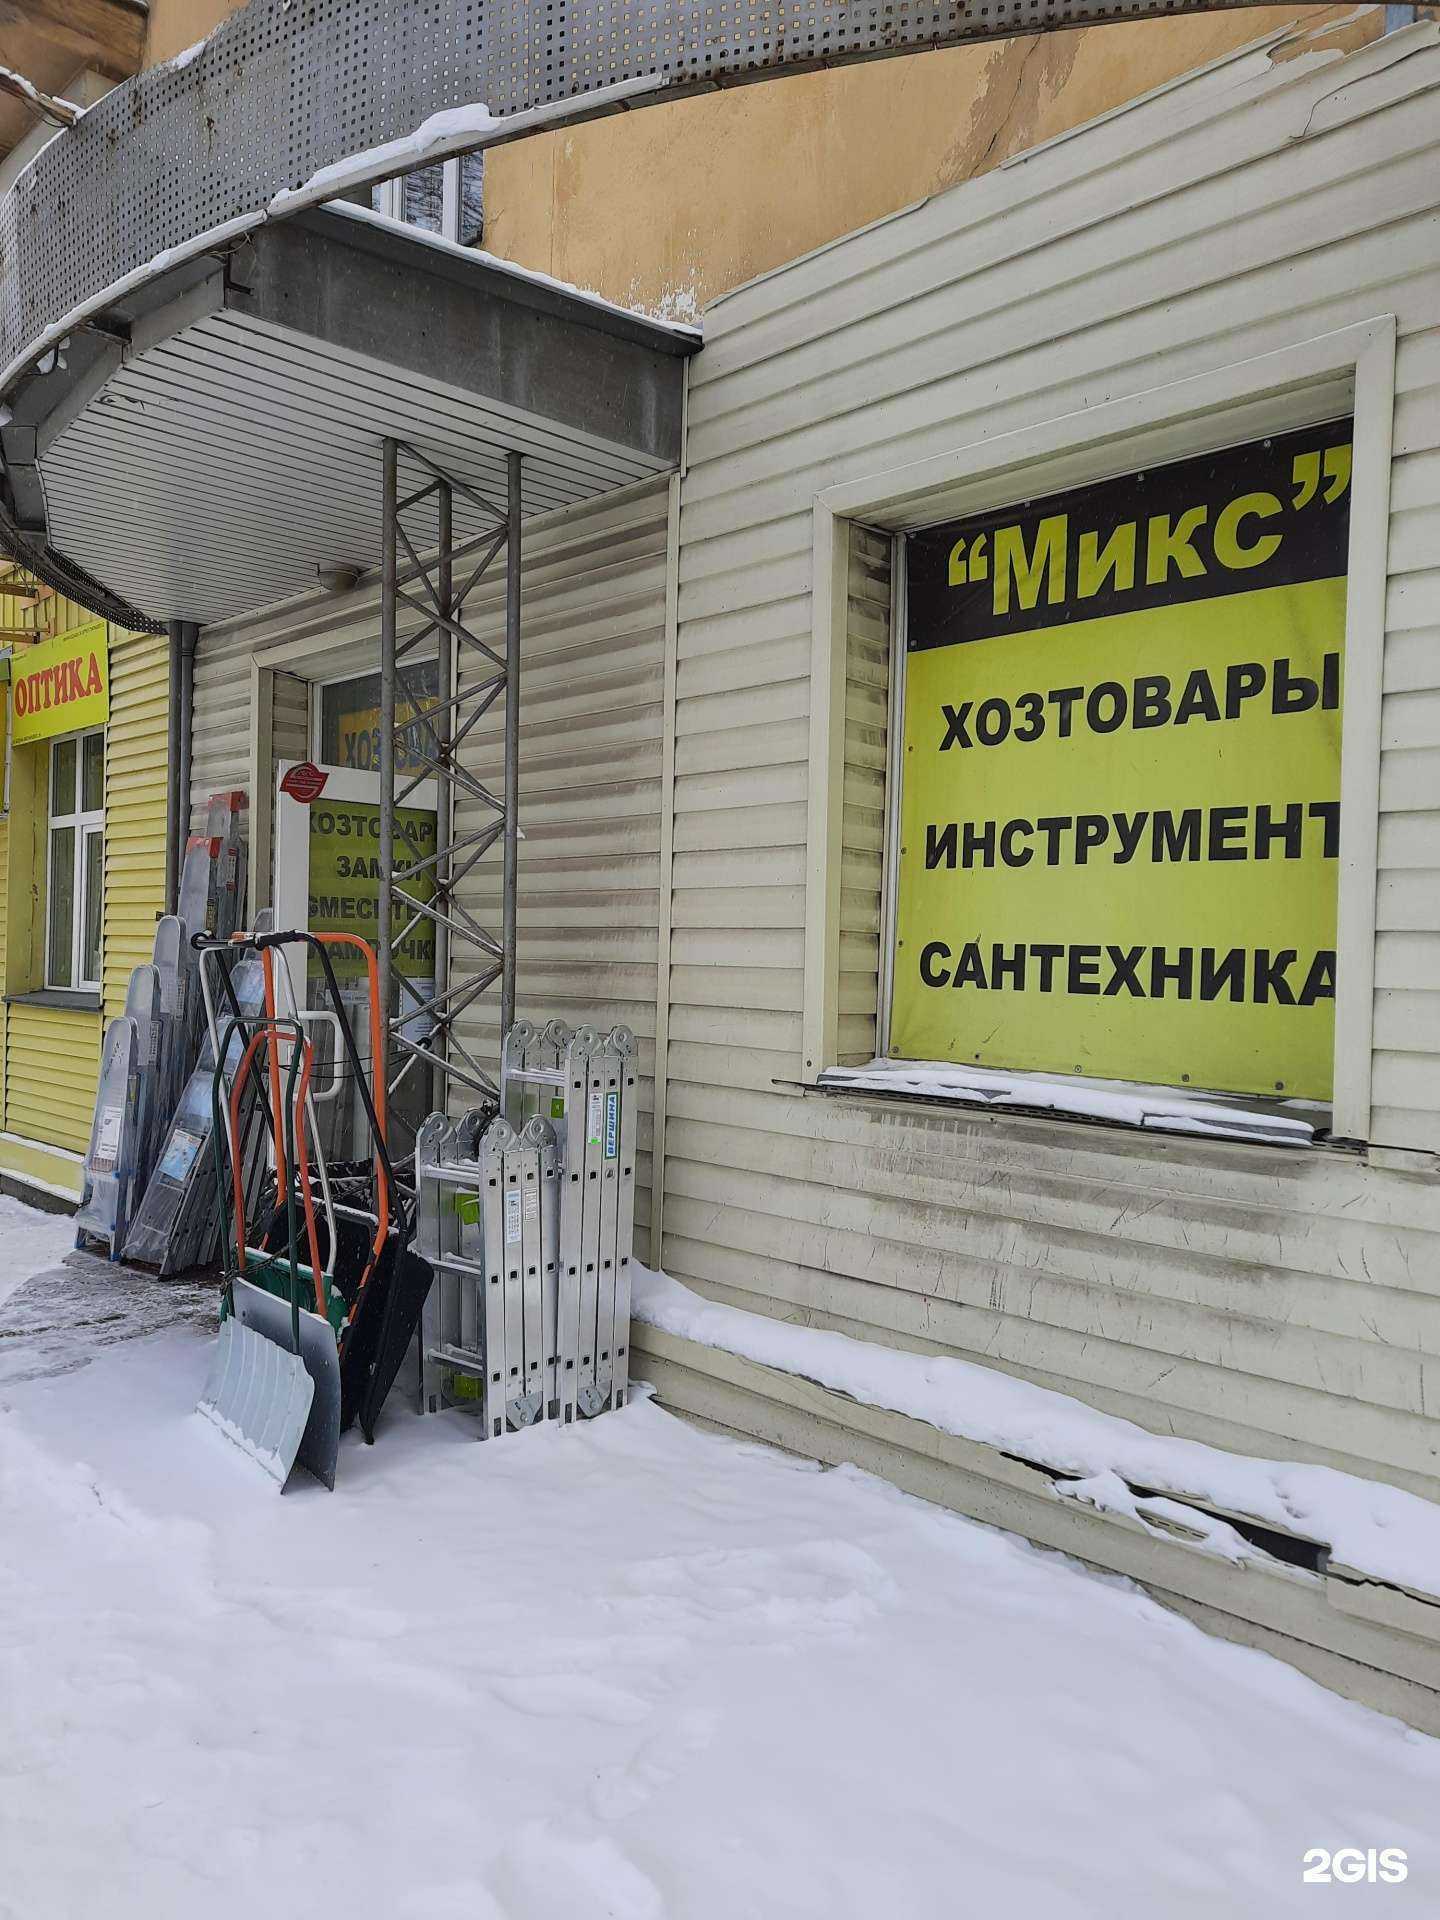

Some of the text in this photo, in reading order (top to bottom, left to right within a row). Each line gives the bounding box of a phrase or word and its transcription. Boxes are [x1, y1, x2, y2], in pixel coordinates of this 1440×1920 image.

[14, 652, 103, 718] ОПТИКА
[939, 653, 1340, 751] ХОЗТОВАРЫ
[925, 801, 1340, 870] ИНСТРУМЕНТ
[919, 941, 1337, 1006] САНТЕХНИКА
[607, 1096, 616, 1154] ВЕРШИНА
